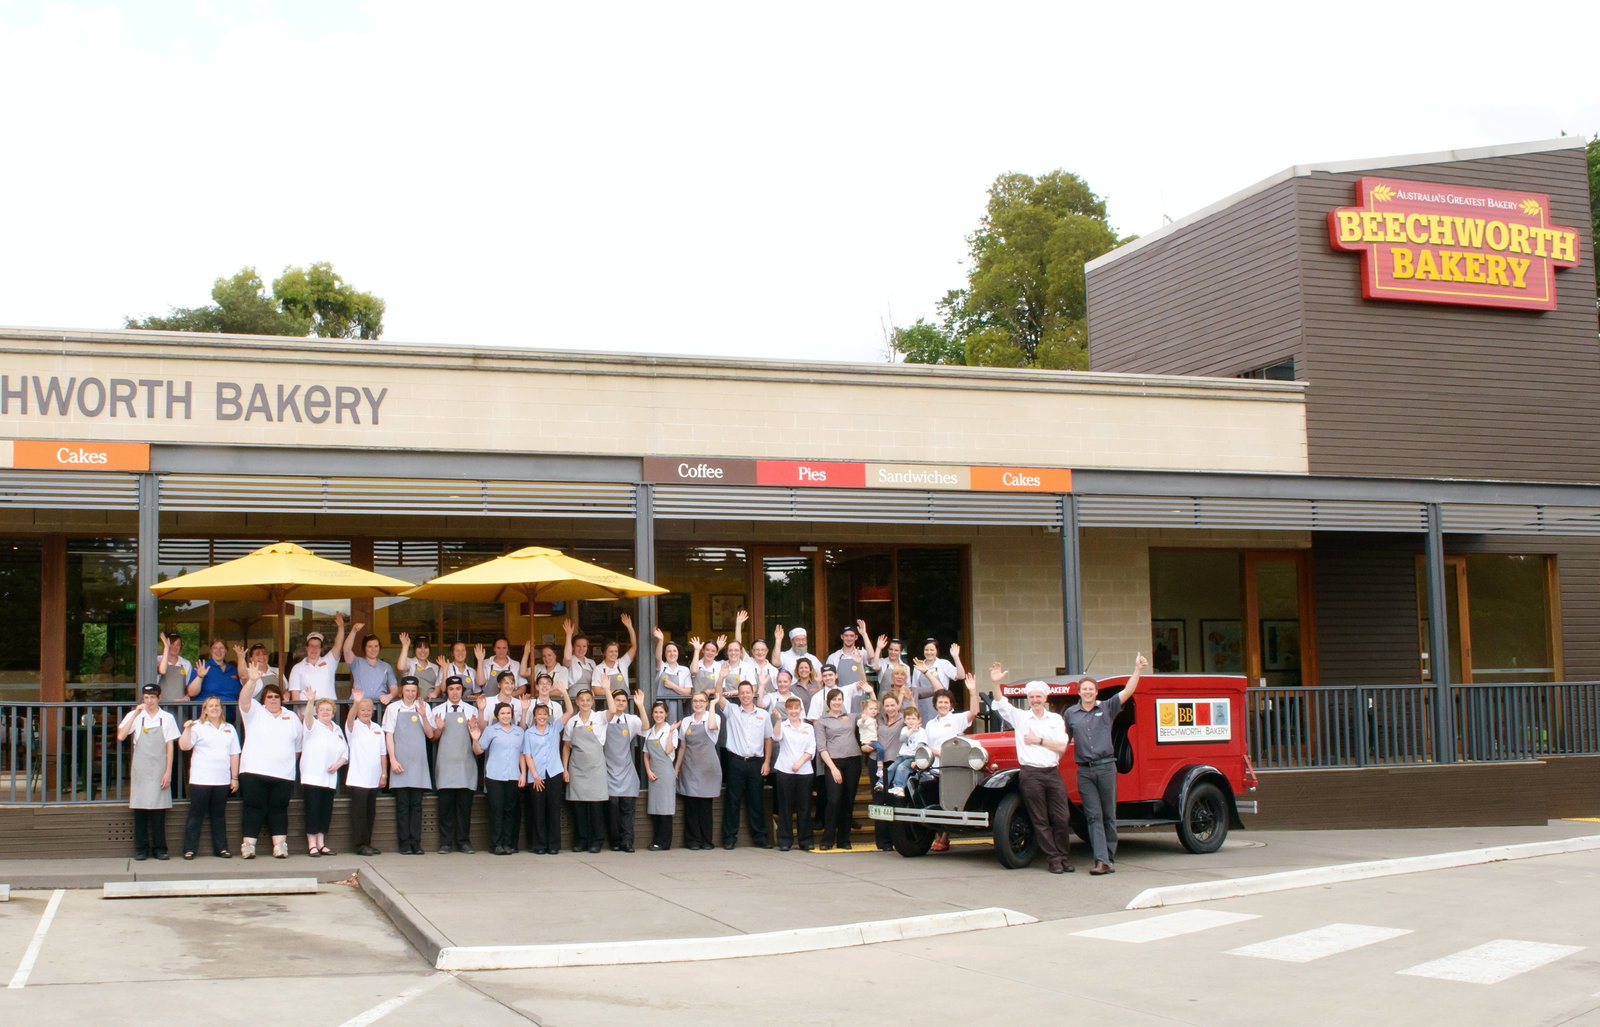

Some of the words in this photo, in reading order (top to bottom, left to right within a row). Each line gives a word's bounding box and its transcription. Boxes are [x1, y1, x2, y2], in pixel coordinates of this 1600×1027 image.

[1396, 189, 1446, 204] AUSTRALIA'S
[1446, 194, 1486, 208] GREATEST
[1487, 197, 1518, 211] BAKERY
[1337, 211, 1576, 262] BEECHWORTH
[1390, 247, 1531, 288] BAKERY
[1, 375, 192, 420] HWORTH
[56, 447, 108, 465] Cakes
[677, 463, 724, 480] Coffee
[798, 466, 827, 482] Pies
[878, 468, 958, 485] Sandwiches
[1002, 472, 1041, 488] Cakes
[1048, 686, 1070, 694] AKERY
[1178, 707, 1193, 722] BB
[1160, 727, 1202, 737] BEECHWORTH
[1205, 726, 1229, 736] BAKERY
